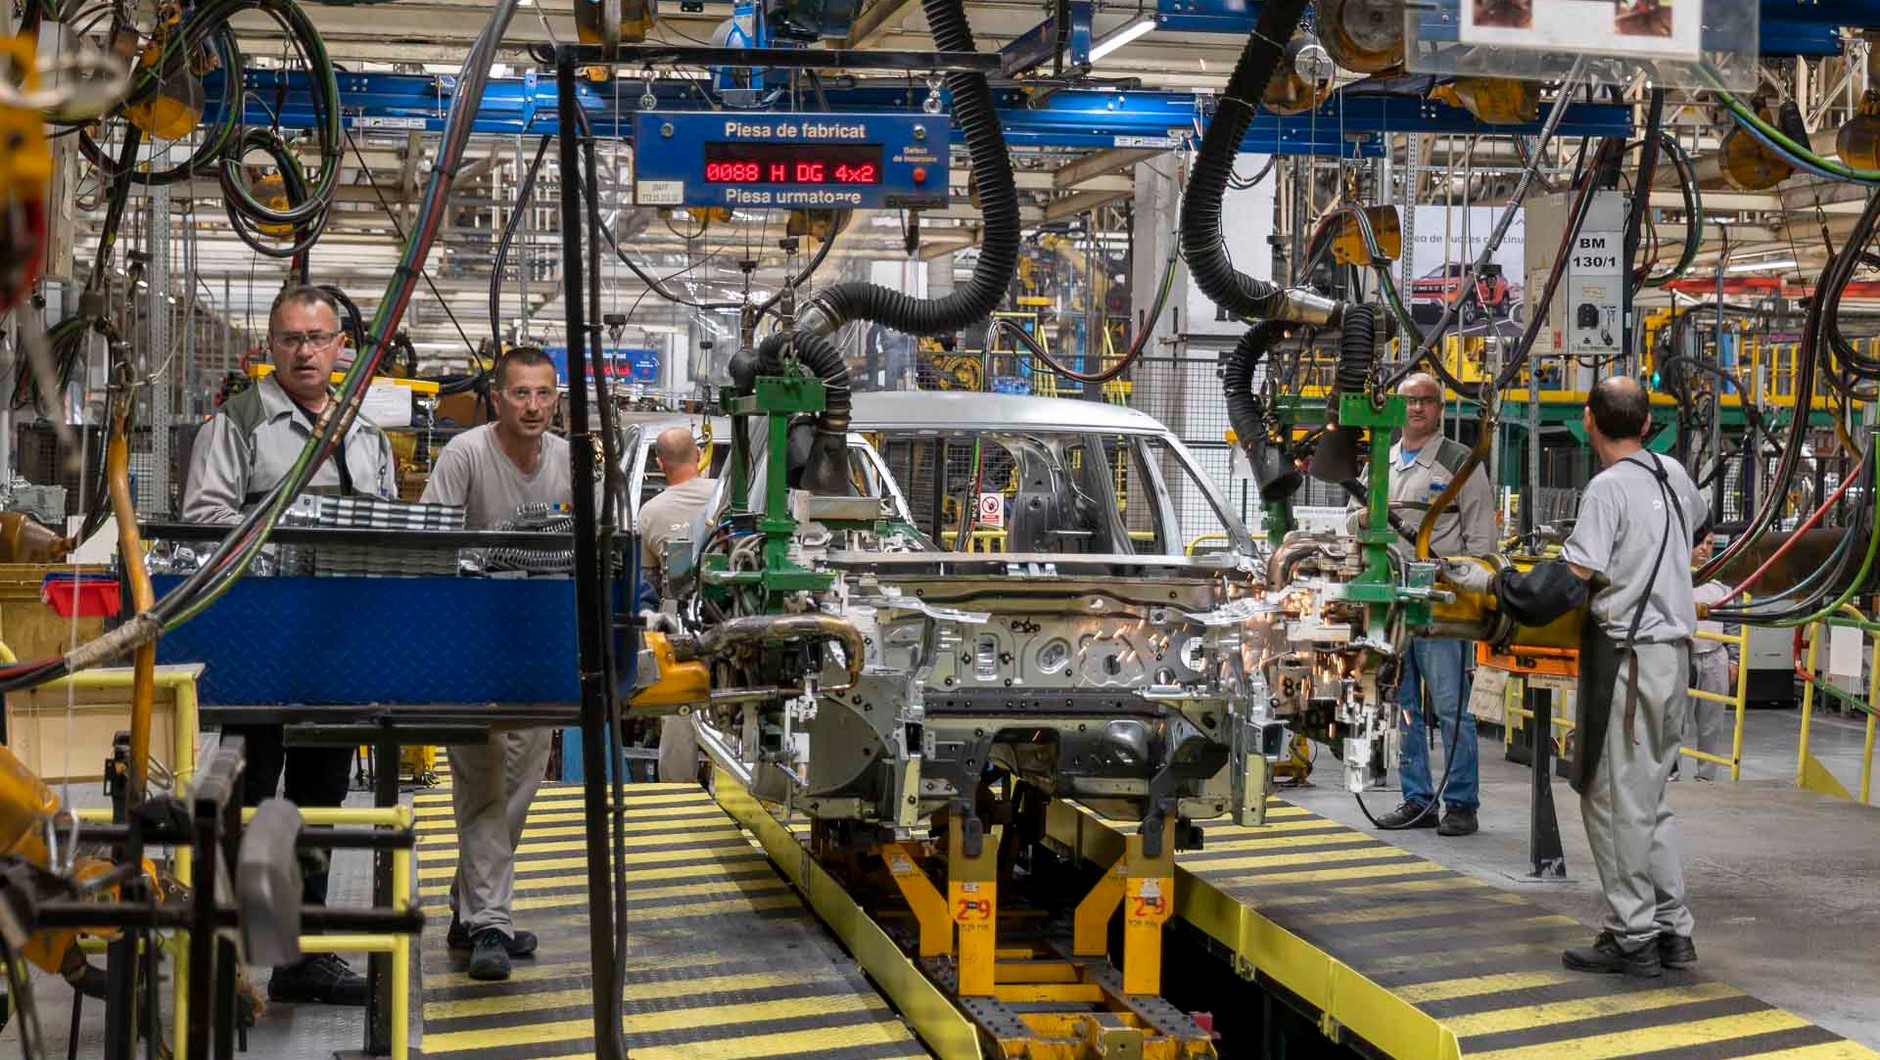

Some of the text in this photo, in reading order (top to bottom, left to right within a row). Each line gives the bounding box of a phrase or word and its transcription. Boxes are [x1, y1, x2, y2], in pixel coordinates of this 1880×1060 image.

[725, 122, 866, 139] Piesa de fabricat
[706, 163, 875, 182] 0088 H DG 4x2
[725, 188, 862, 205] Piesa urmatoare
[1580, 238, 1605, 249] BM
[1573, 256, 1616, 268] 130/1
